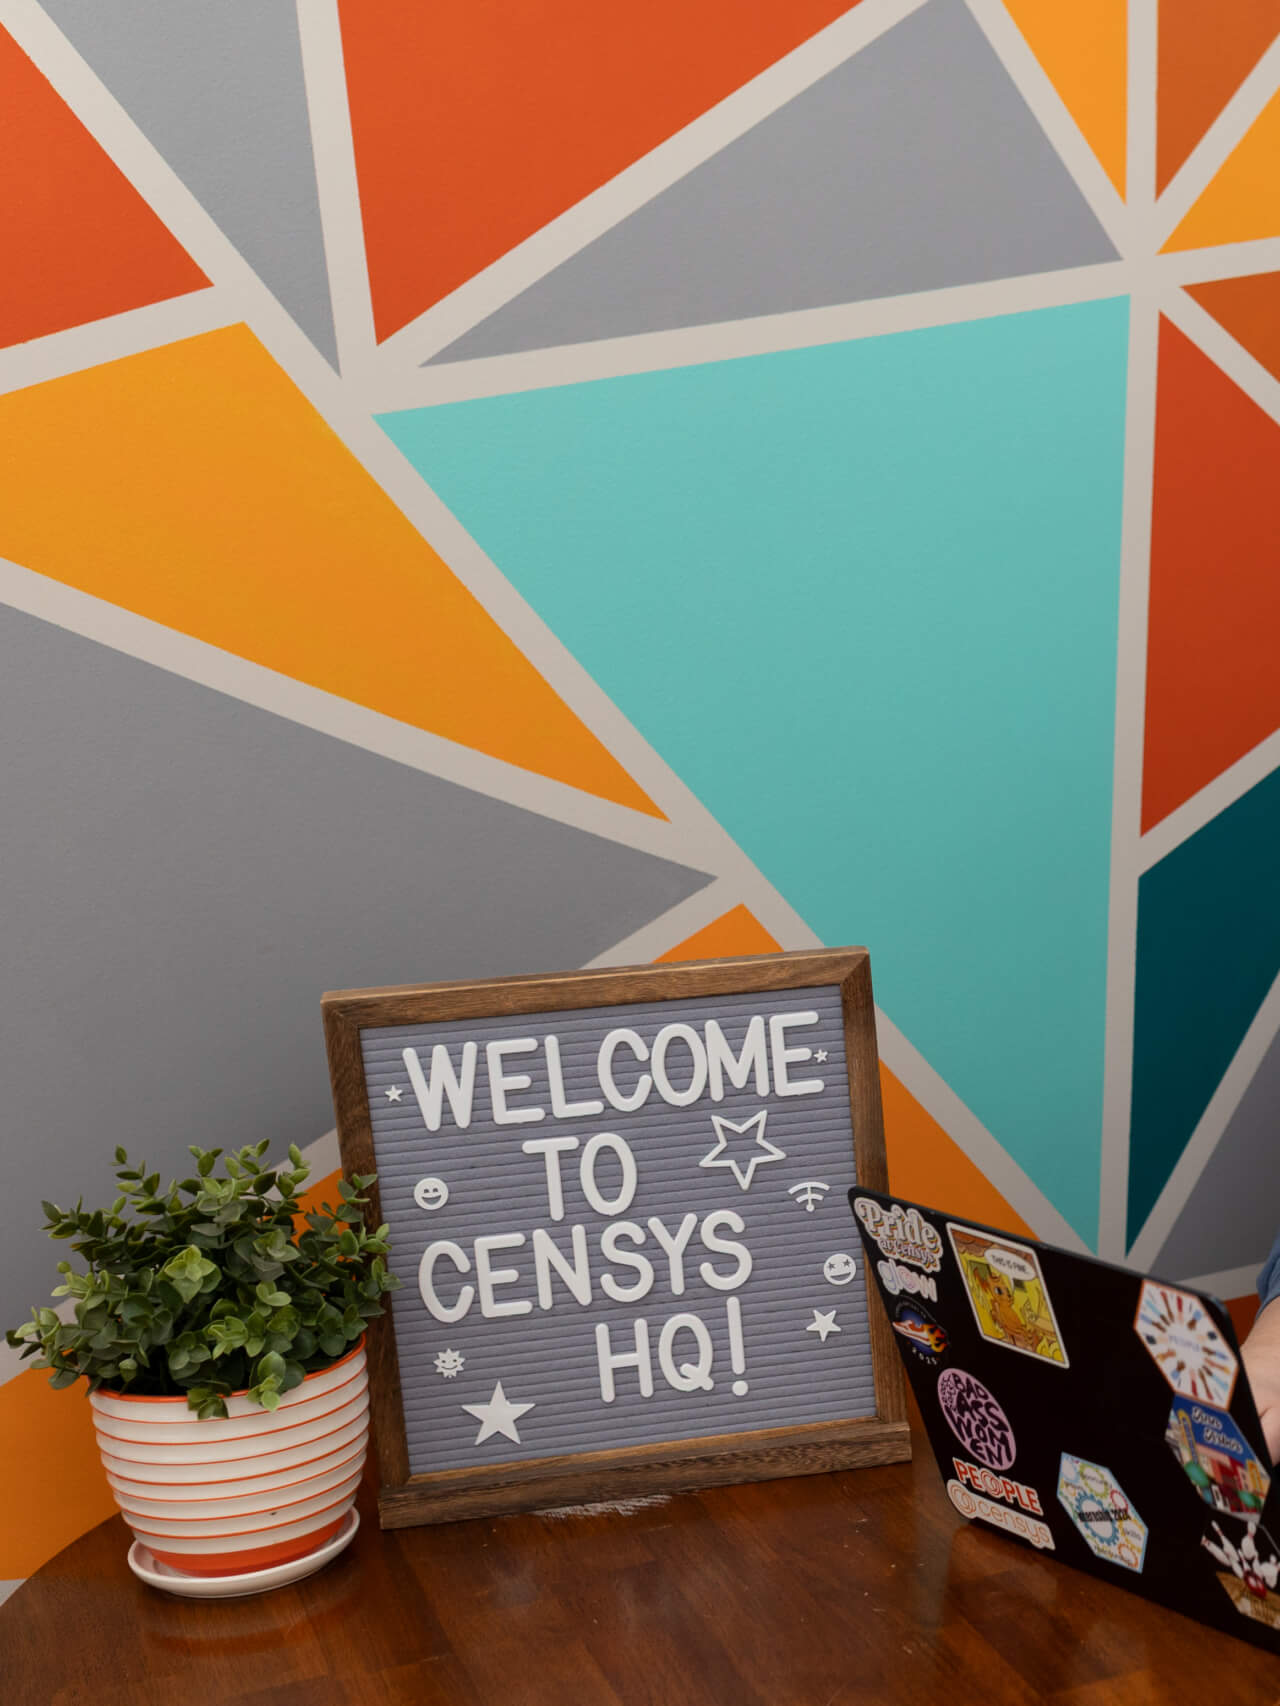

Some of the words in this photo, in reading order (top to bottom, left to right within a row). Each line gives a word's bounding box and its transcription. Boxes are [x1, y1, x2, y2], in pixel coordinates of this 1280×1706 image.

[402, 1011, 826, 1132] WELCOME
[522, 1132, 637, 1221] TO
[857, 1202, 938, 1251] Pride
[418, 1210, 753, 1324] CENSYS
[595, 1296, 749, 1404] HQ!
[952, 1373, 988, 1400] BAD
[956, 1391, 1009, 1432] ASS
[955, 1460, 1041, 1513] PEOPLE
[977, 1500, 1051, 1544] censys
